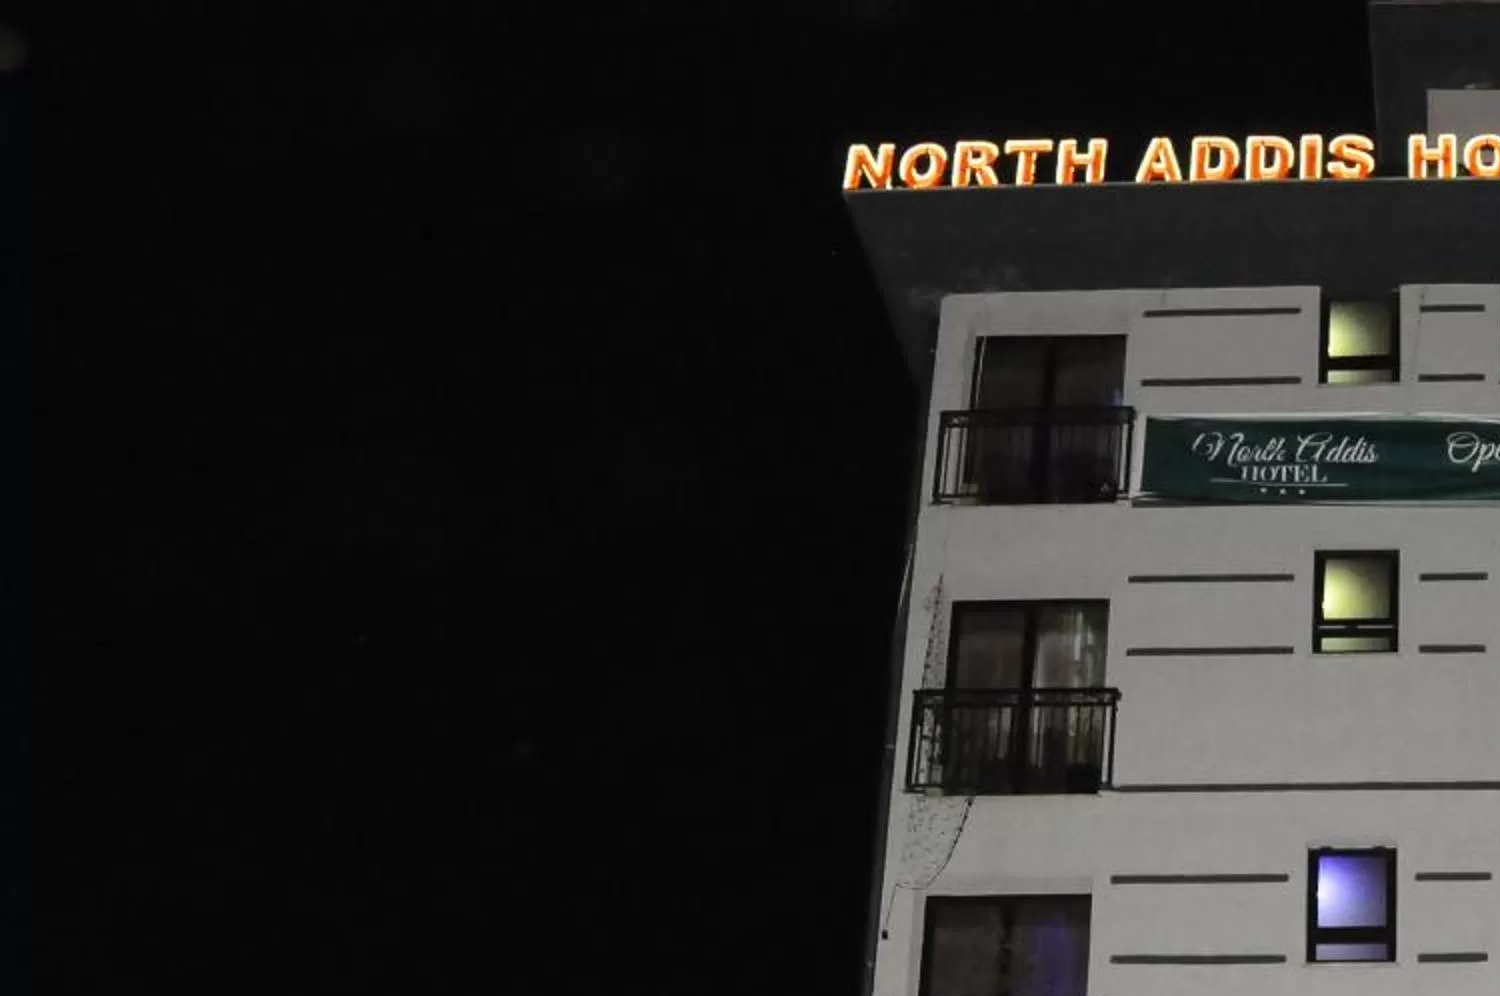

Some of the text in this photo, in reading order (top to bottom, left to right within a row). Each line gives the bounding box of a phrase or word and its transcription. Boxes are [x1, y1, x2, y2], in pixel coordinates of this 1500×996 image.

[842, 138, 1109, 190] NORTH
[1134, 132, 1376, 184] ADDIS
[1191, 432, 1379, 467] North Addis
[1241, 464, 1328, 482] HOTEL
